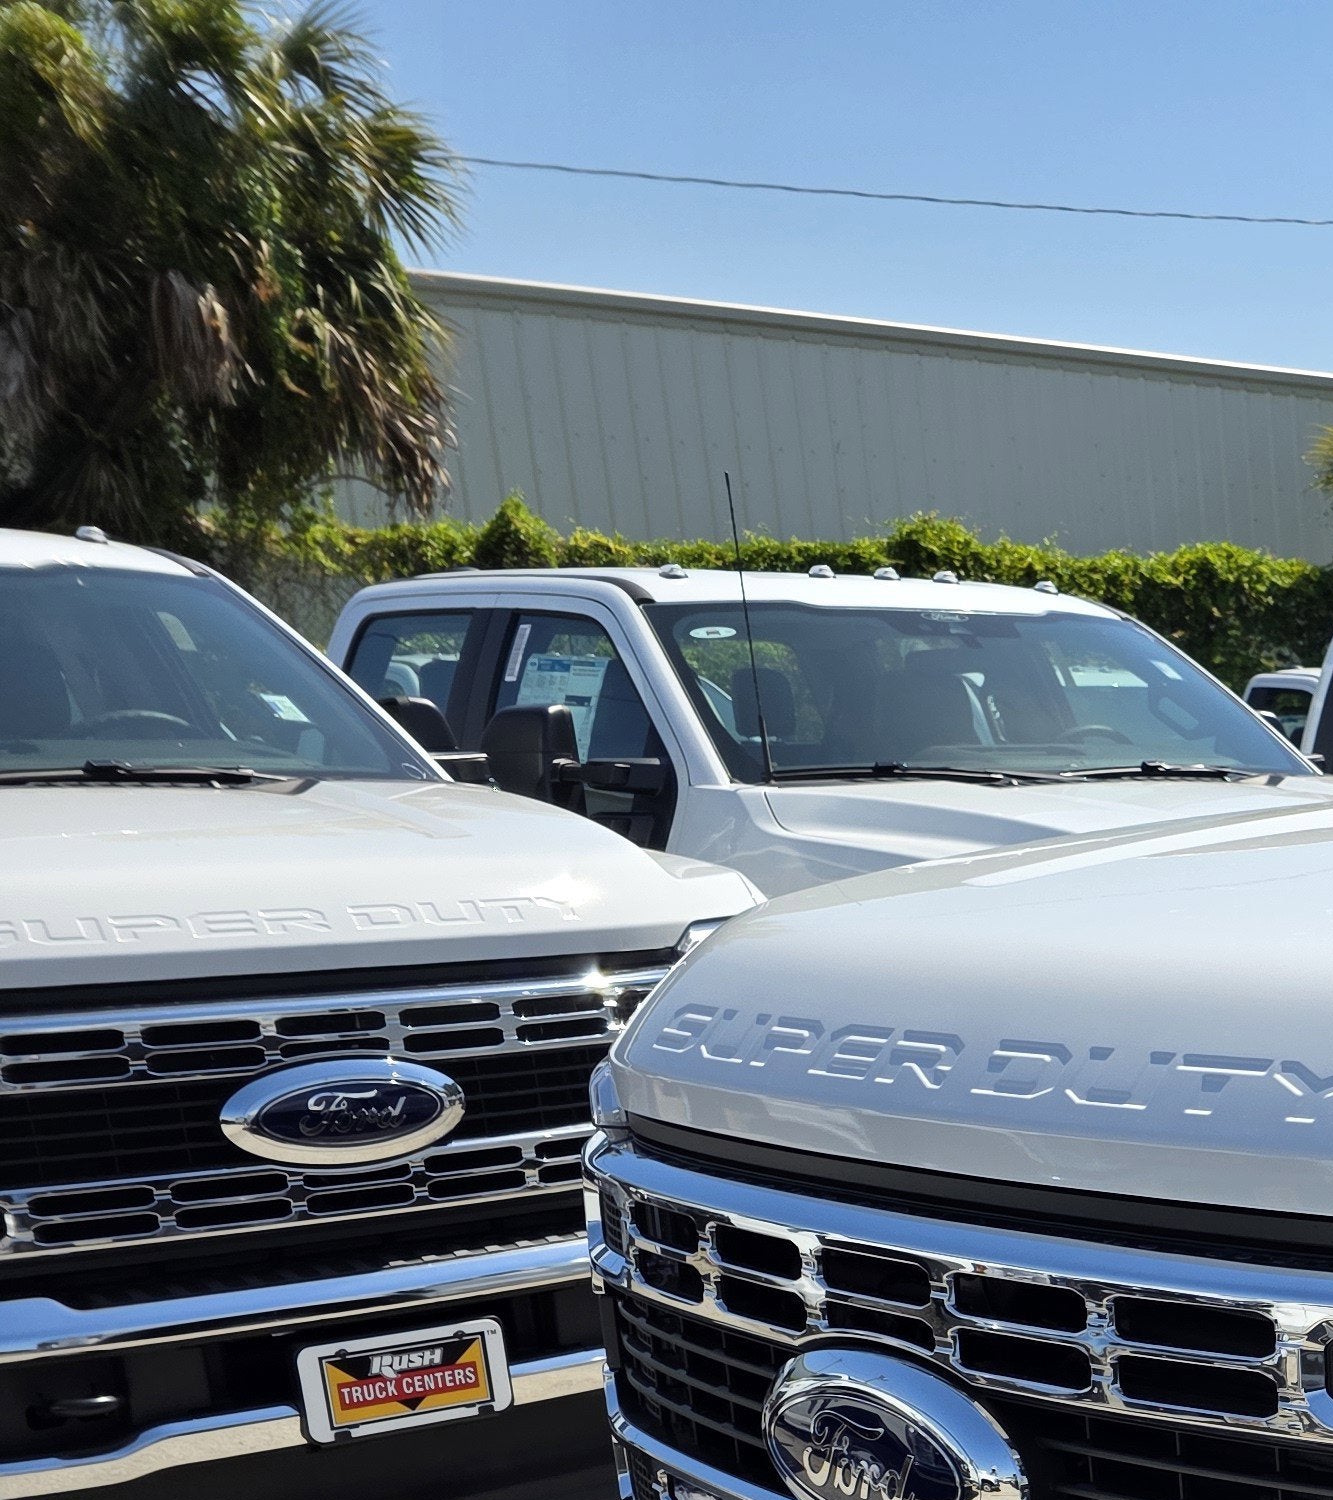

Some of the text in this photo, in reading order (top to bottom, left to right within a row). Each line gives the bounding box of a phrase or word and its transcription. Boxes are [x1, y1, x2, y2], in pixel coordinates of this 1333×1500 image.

[0, 896, 584, 948] UPER DUTY
[652, 1004, 967, 1089] SUPER
[299, 1088, 407, 1137] Ford
[340, 1366, 477, 1405] TRUCK CENTERS
[367, 1346, 444, 1379] RUSH
